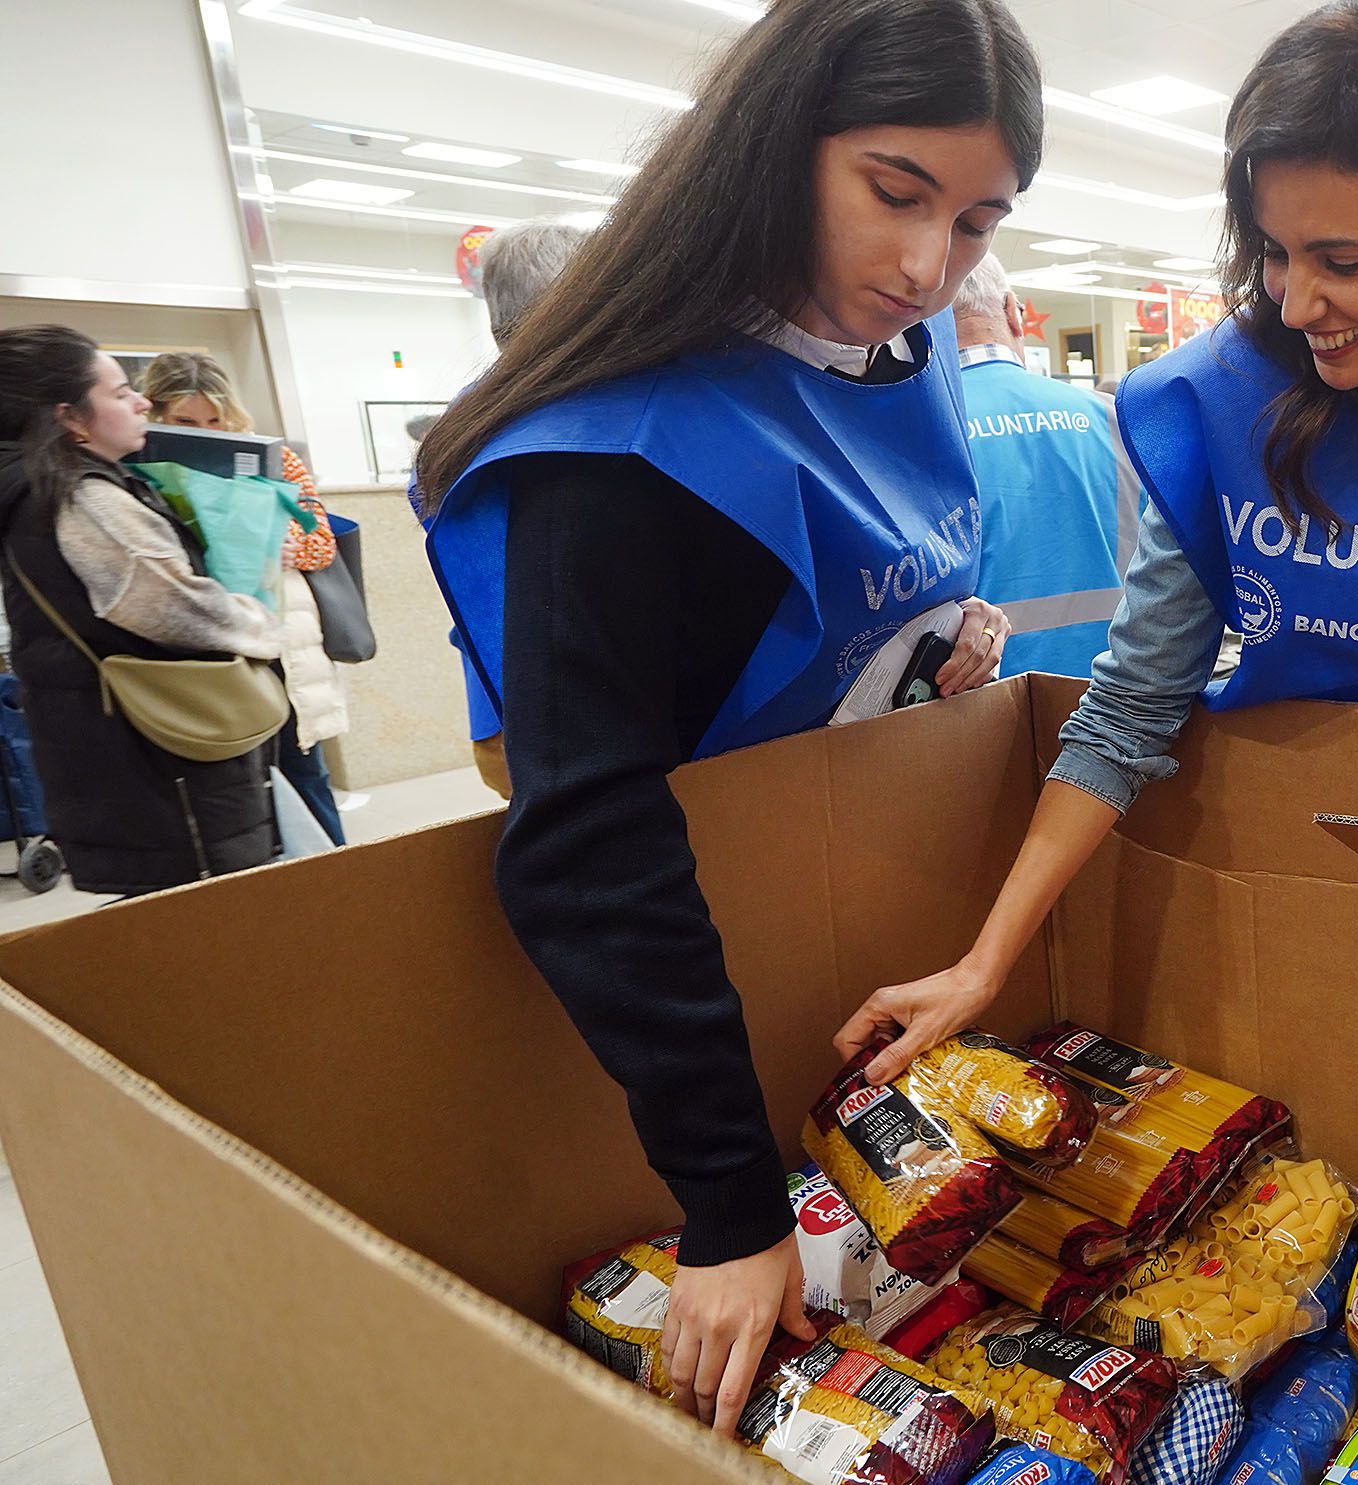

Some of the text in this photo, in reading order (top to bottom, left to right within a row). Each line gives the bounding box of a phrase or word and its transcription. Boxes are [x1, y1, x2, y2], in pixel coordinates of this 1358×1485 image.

[1248, 569, 1282, 613] ALIMENTOS
[1058, 1032, 1091, 1057] FROIZ
[840, 1086, 887, 1124] FROIZ
[863, 1106, 886, 1125] FIDEO
[866, 1110, 896, 1133] ALETRIA
[865, 1111, 906, 1144] VERMICELLI
[1065, 1343, 1092, 1360] PASTA
[1082, 1350, 1133, 1388] FROIZ
[1208, 1420, 1230, 1461] FROIZ
